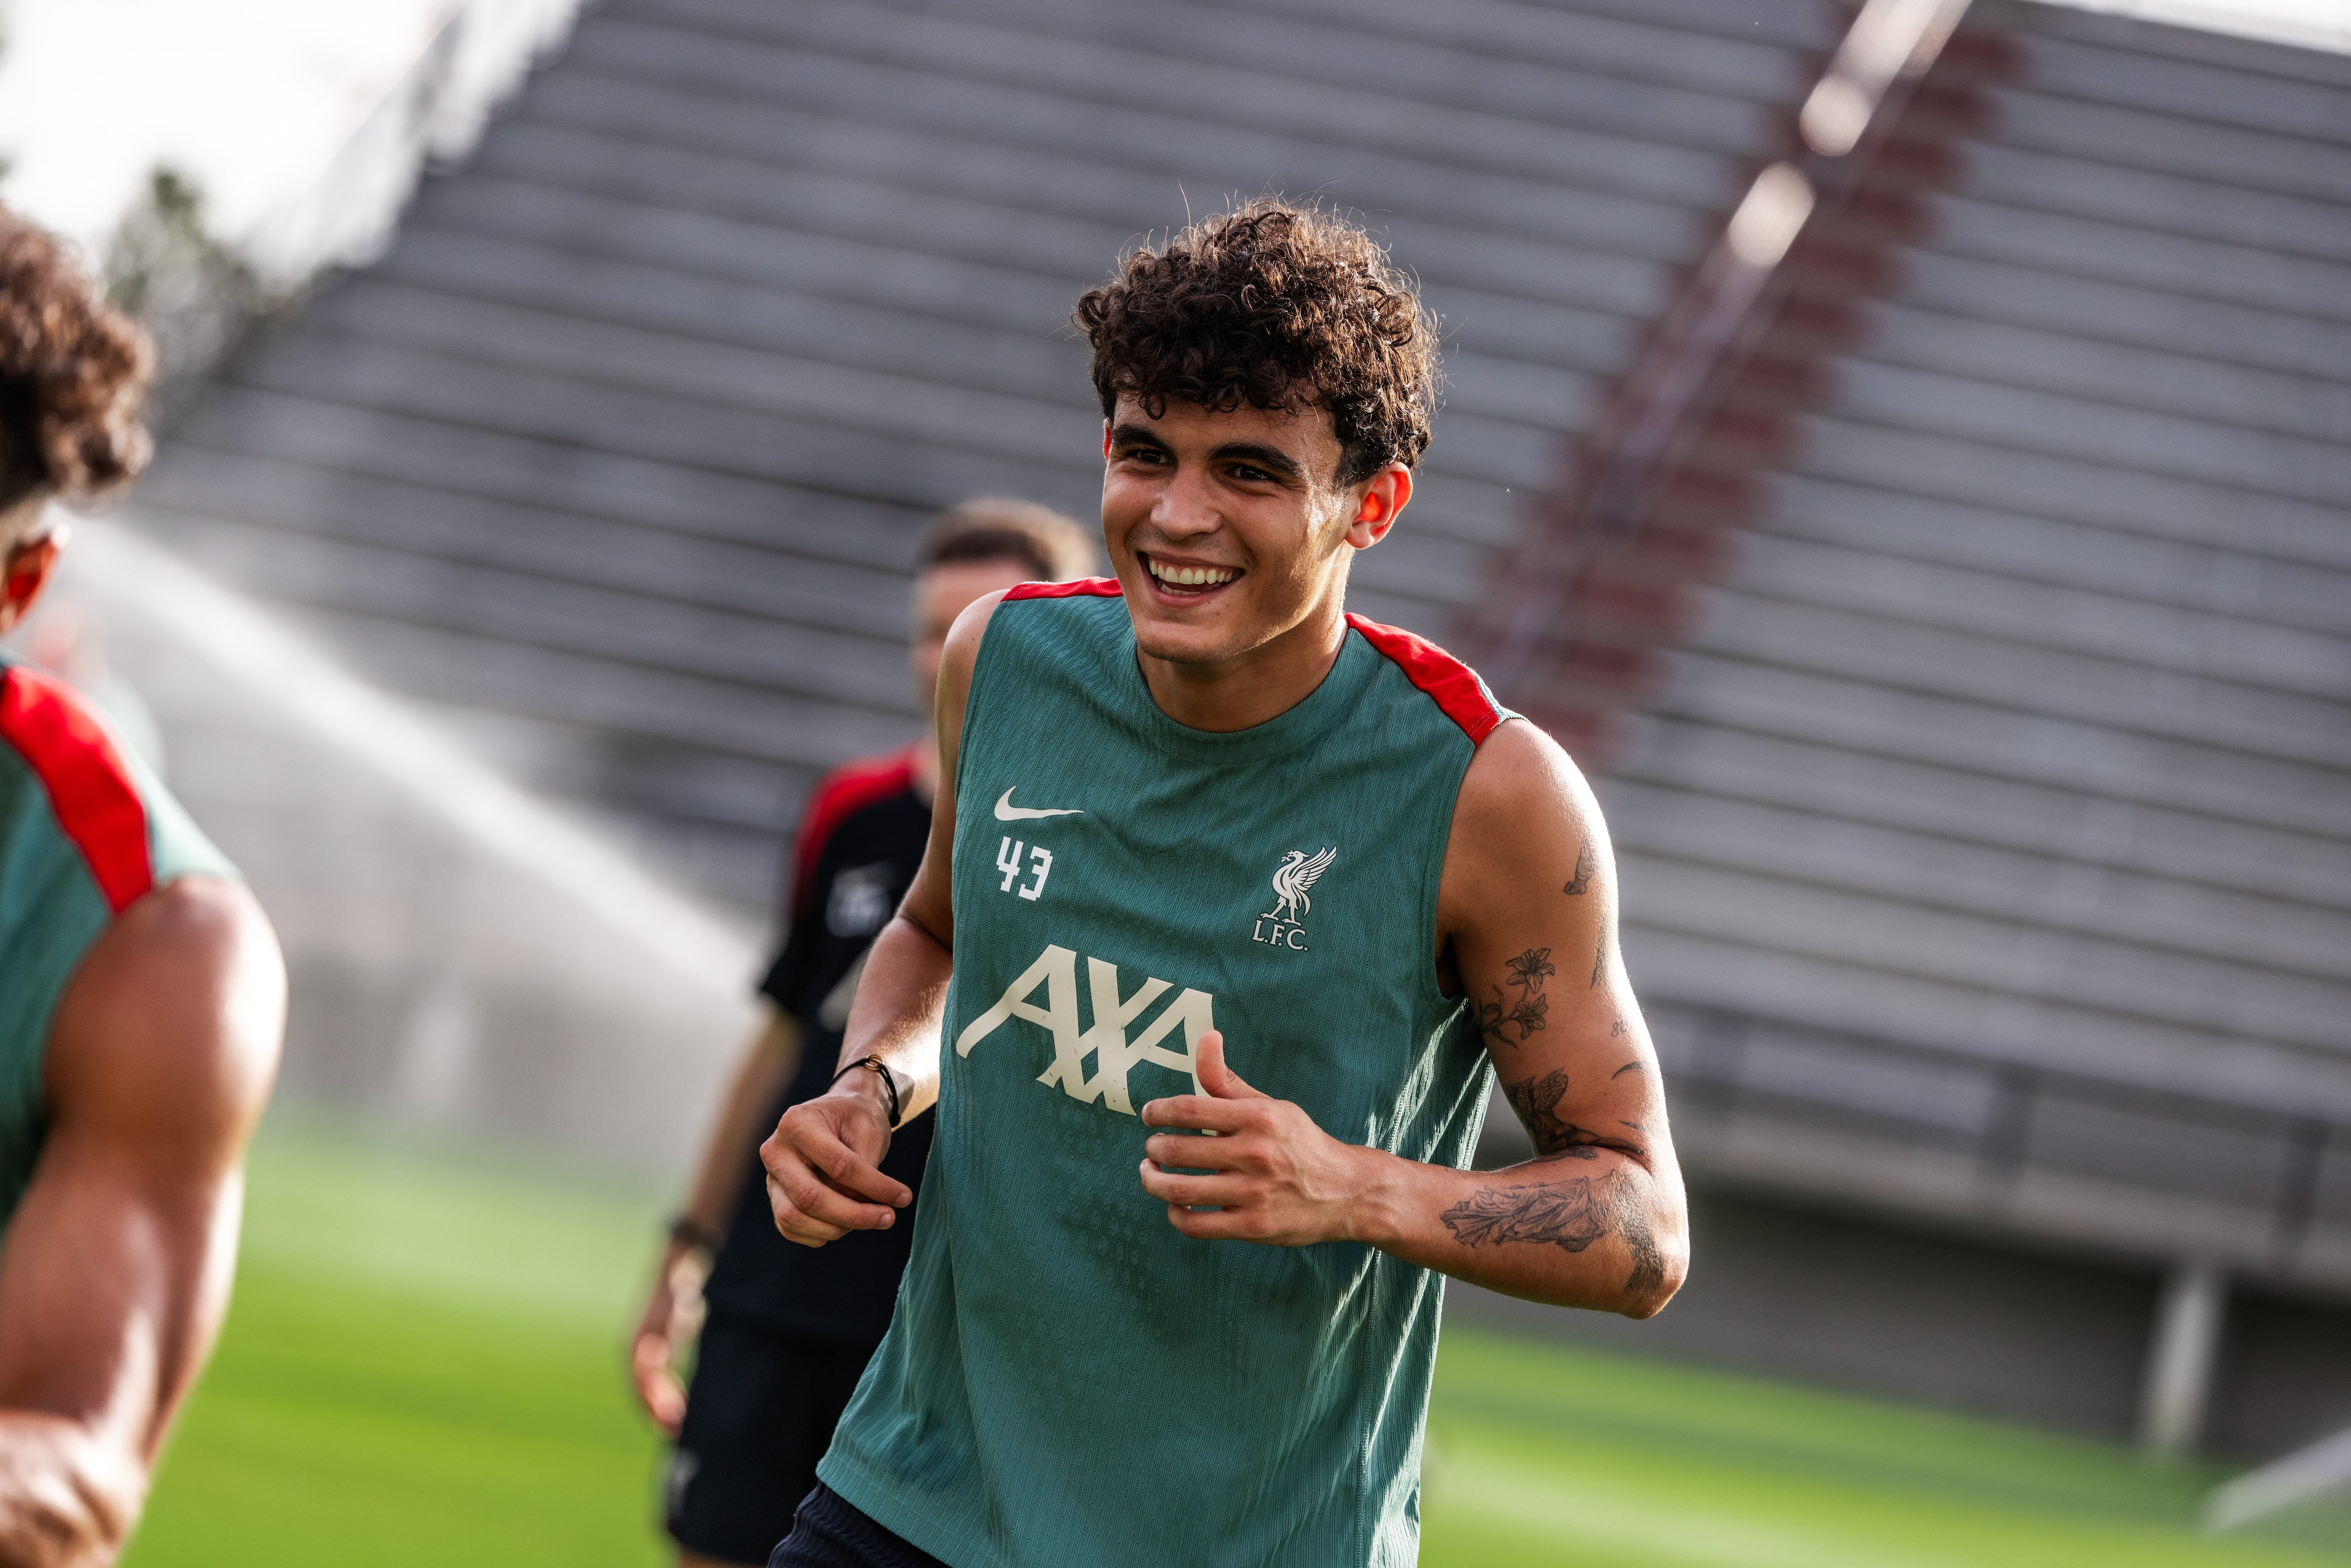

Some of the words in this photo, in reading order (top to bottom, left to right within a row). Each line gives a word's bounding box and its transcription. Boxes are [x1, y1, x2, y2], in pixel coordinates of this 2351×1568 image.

[996, 836, 1053, 901] 43
[1252, 919, 1308, 951] L.F.C.
[956, 944, 1217, 1136] AXA
